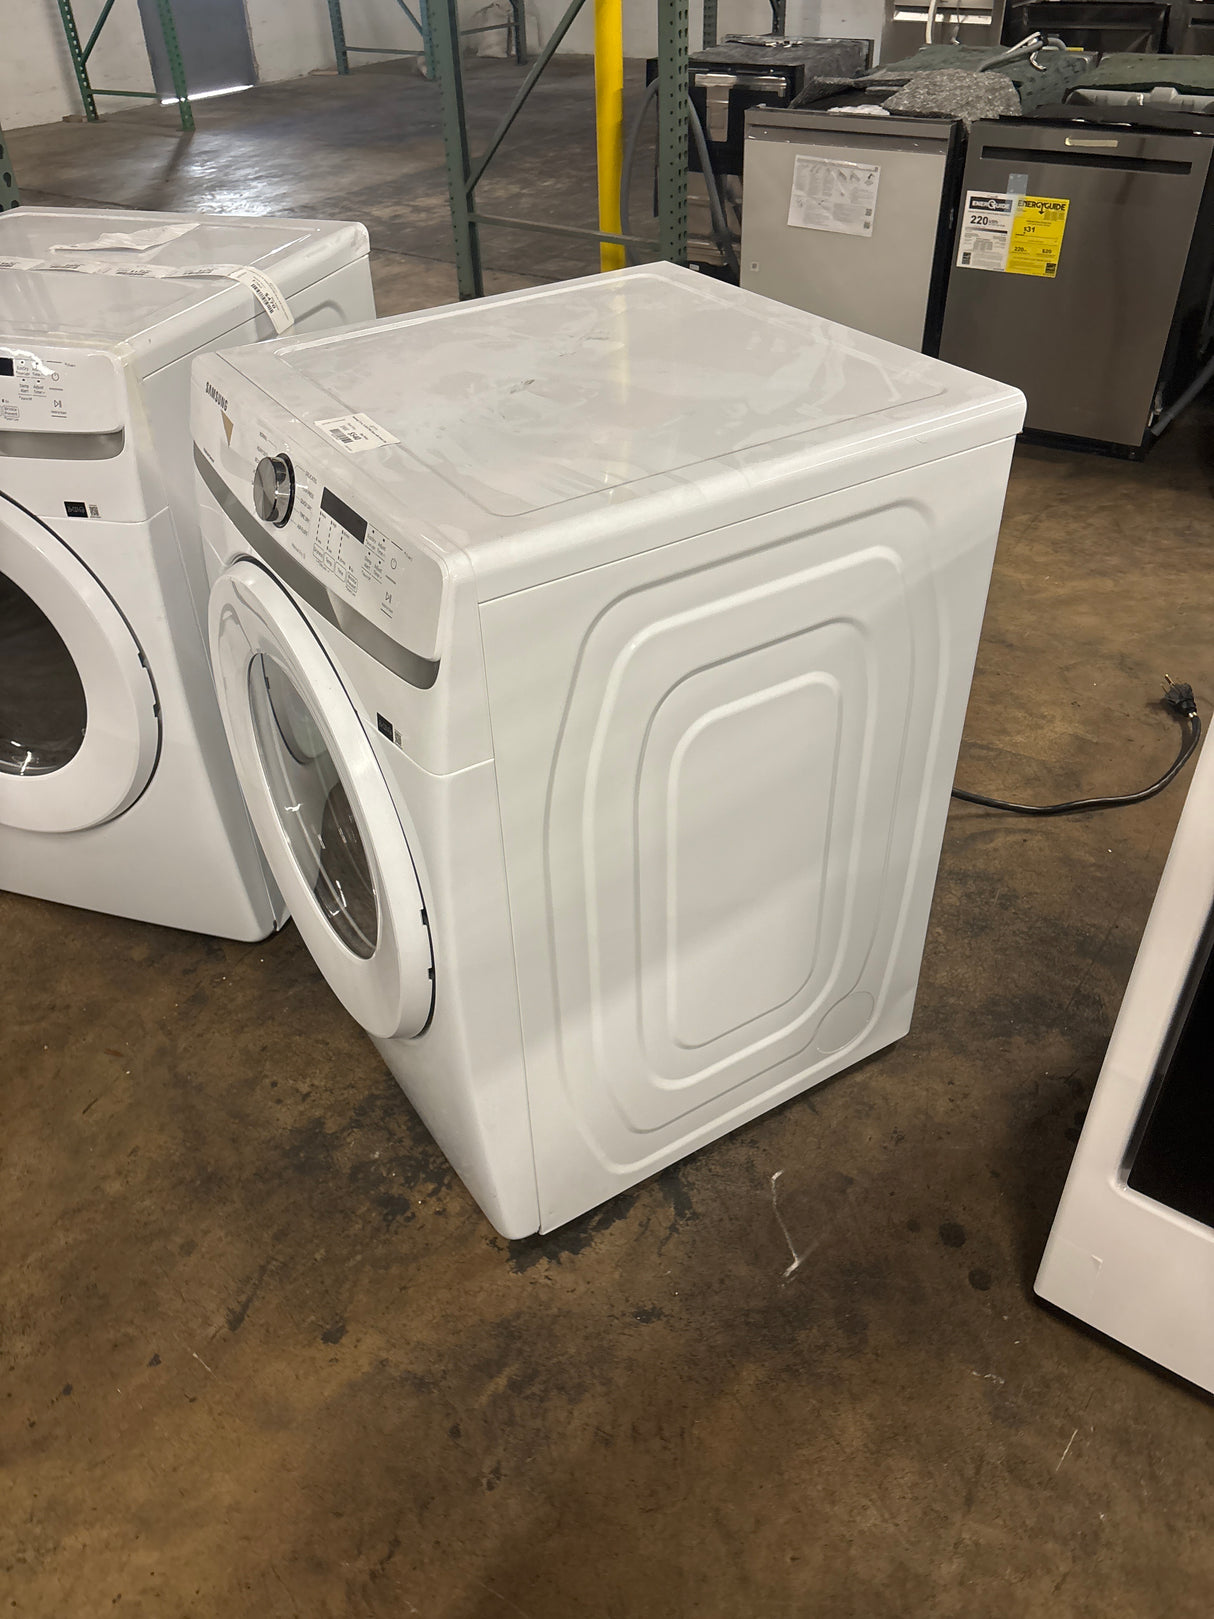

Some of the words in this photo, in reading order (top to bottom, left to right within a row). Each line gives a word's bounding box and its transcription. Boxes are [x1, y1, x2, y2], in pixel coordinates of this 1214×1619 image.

[1018, 200, 1066, 211] ENERGYGUIDE
[970, 215, 989, 226] 220
[205, 381, 228, 412] SAMSUNG
